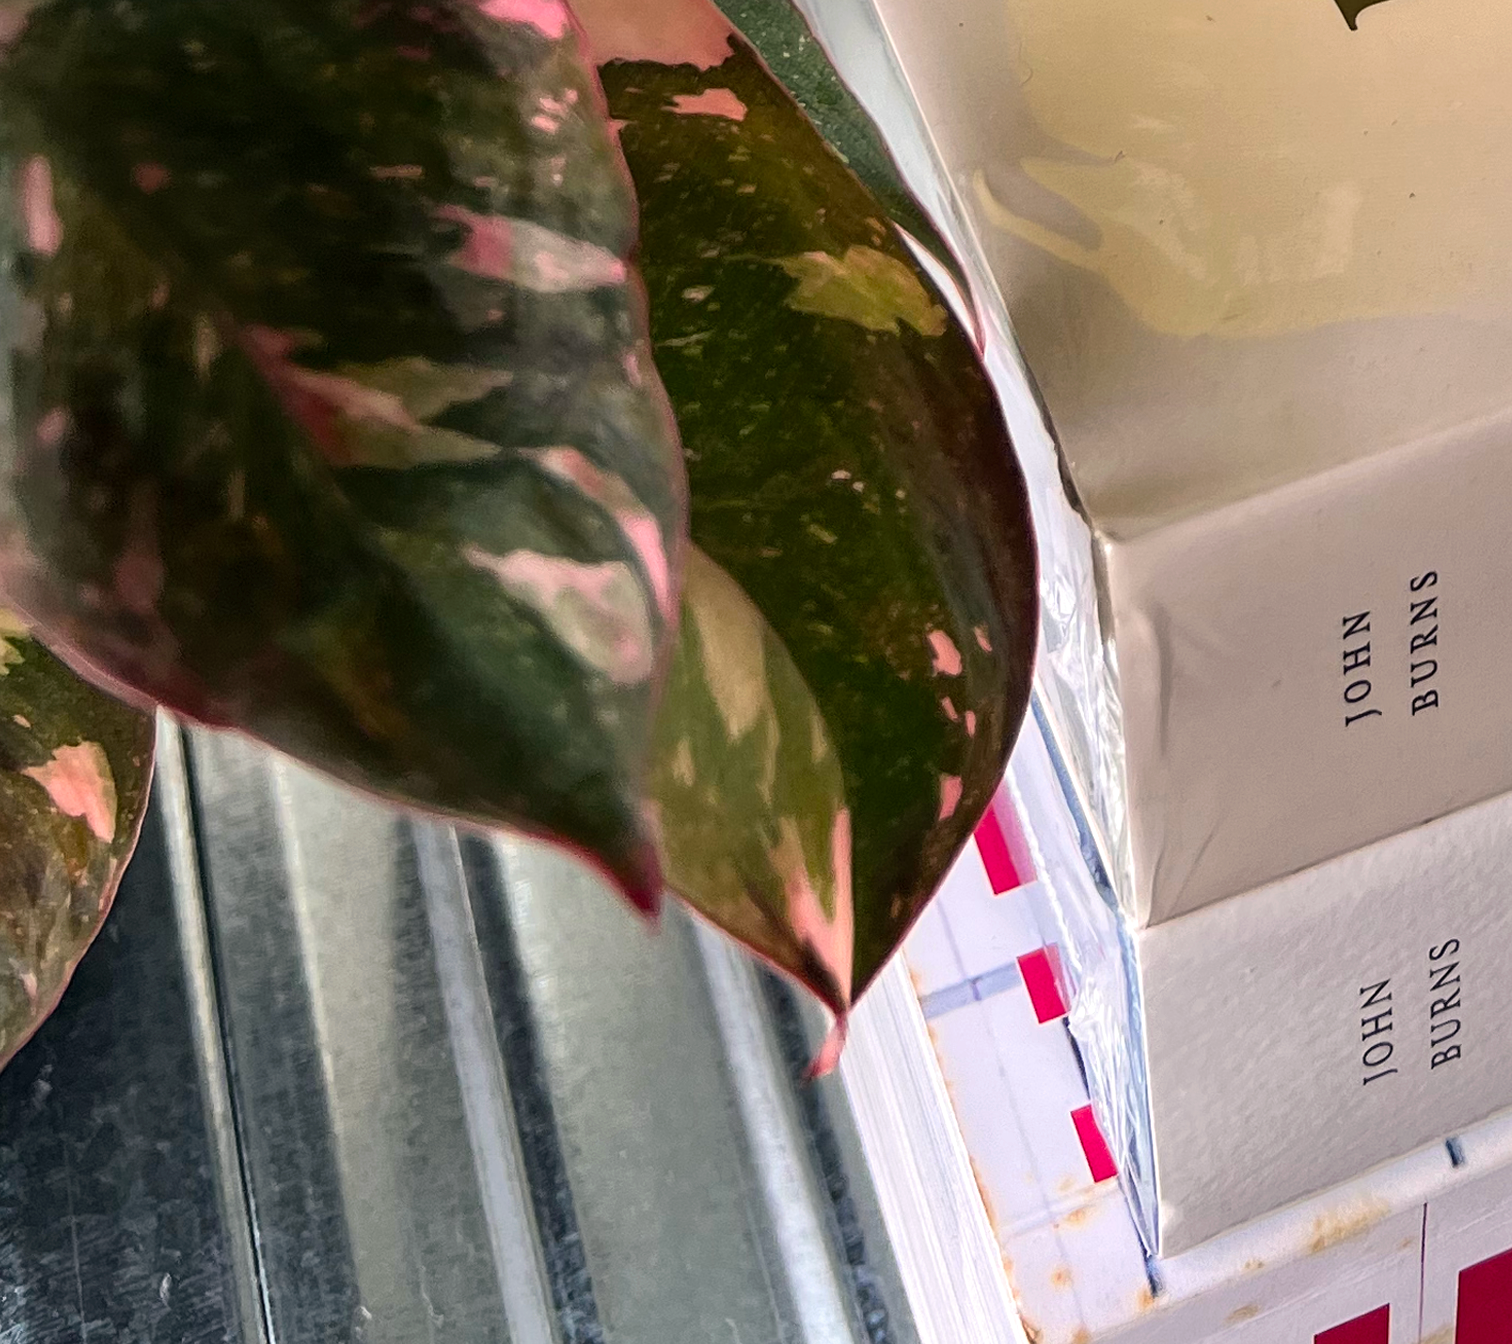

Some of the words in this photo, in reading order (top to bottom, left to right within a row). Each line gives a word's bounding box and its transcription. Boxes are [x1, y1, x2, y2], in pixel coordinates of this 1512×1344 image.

[1342, 610, 1382, 726] JOHN
[1410, 570, 1439, 716] BURNS
[1360, 978, 1398, 1086] JOHN
[1429, 938, 1461, 1069] BURNS
